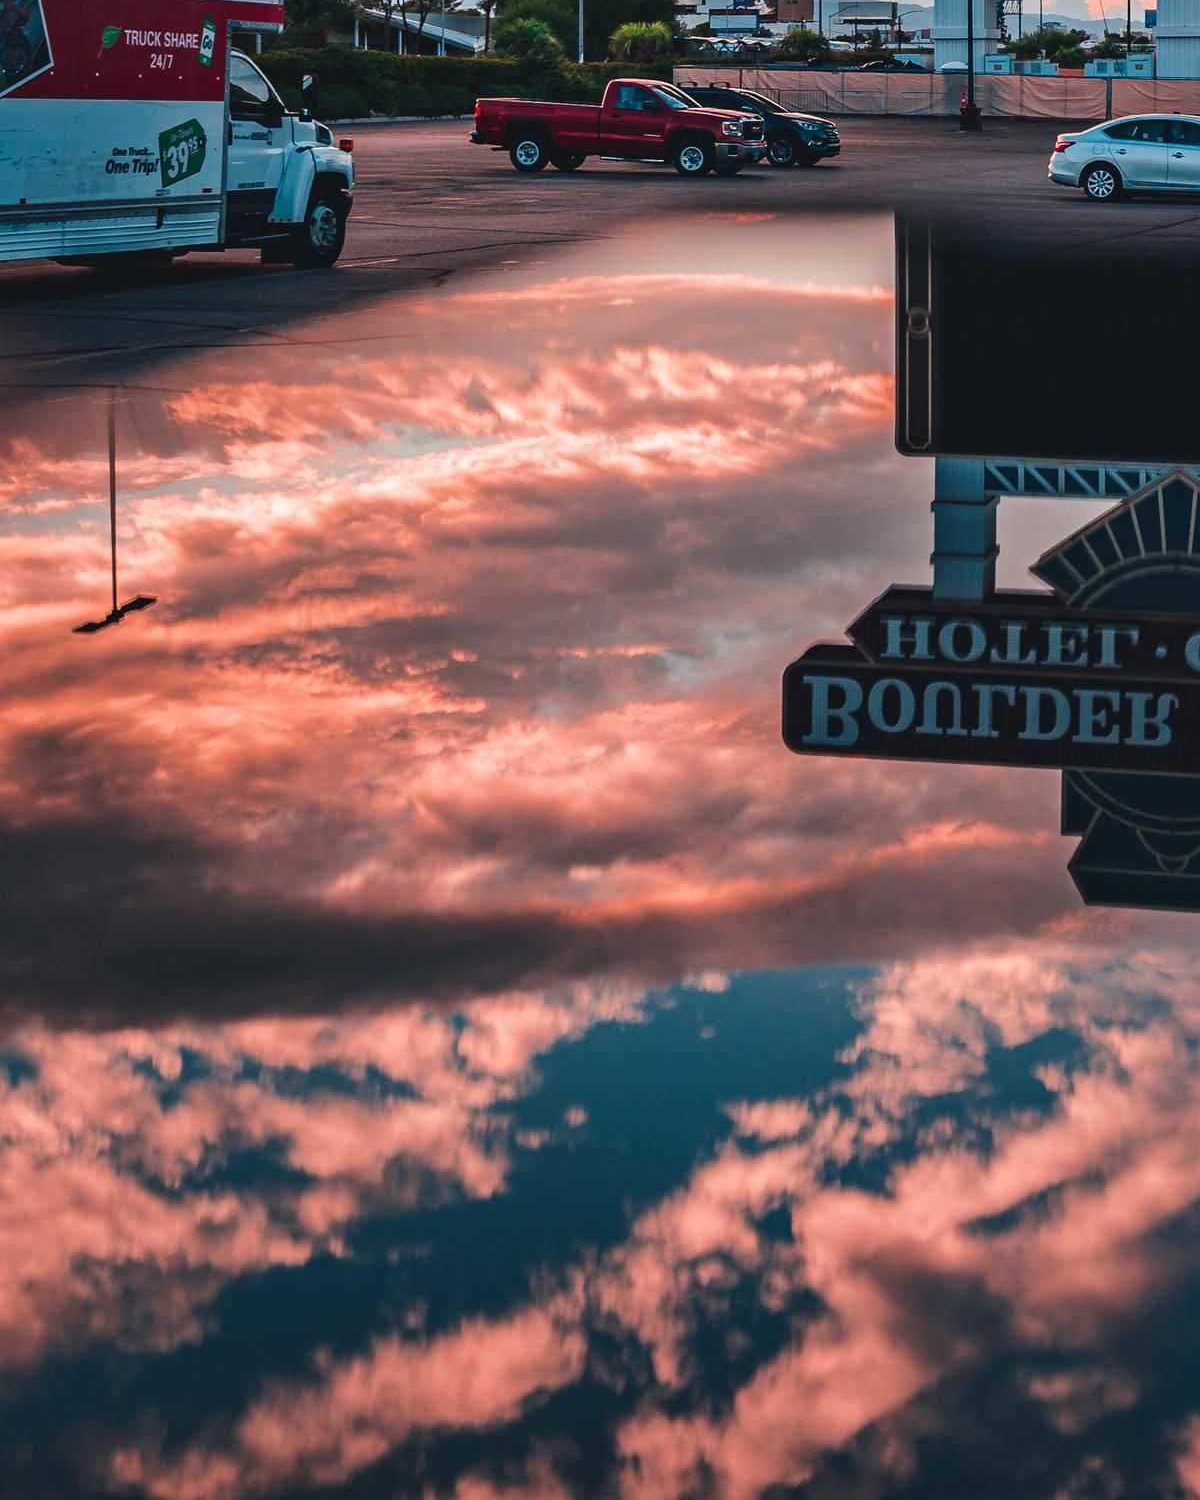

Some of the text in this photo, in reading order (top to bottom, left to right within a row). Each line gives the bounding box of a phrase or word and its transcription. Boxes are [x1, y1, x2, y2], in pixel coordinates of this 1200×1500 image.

[124, 29, 200, 49] TRUCK SHARE
[150, 53, 174, 70] 24/7
[105, 158, 160, 176] One Trip!
